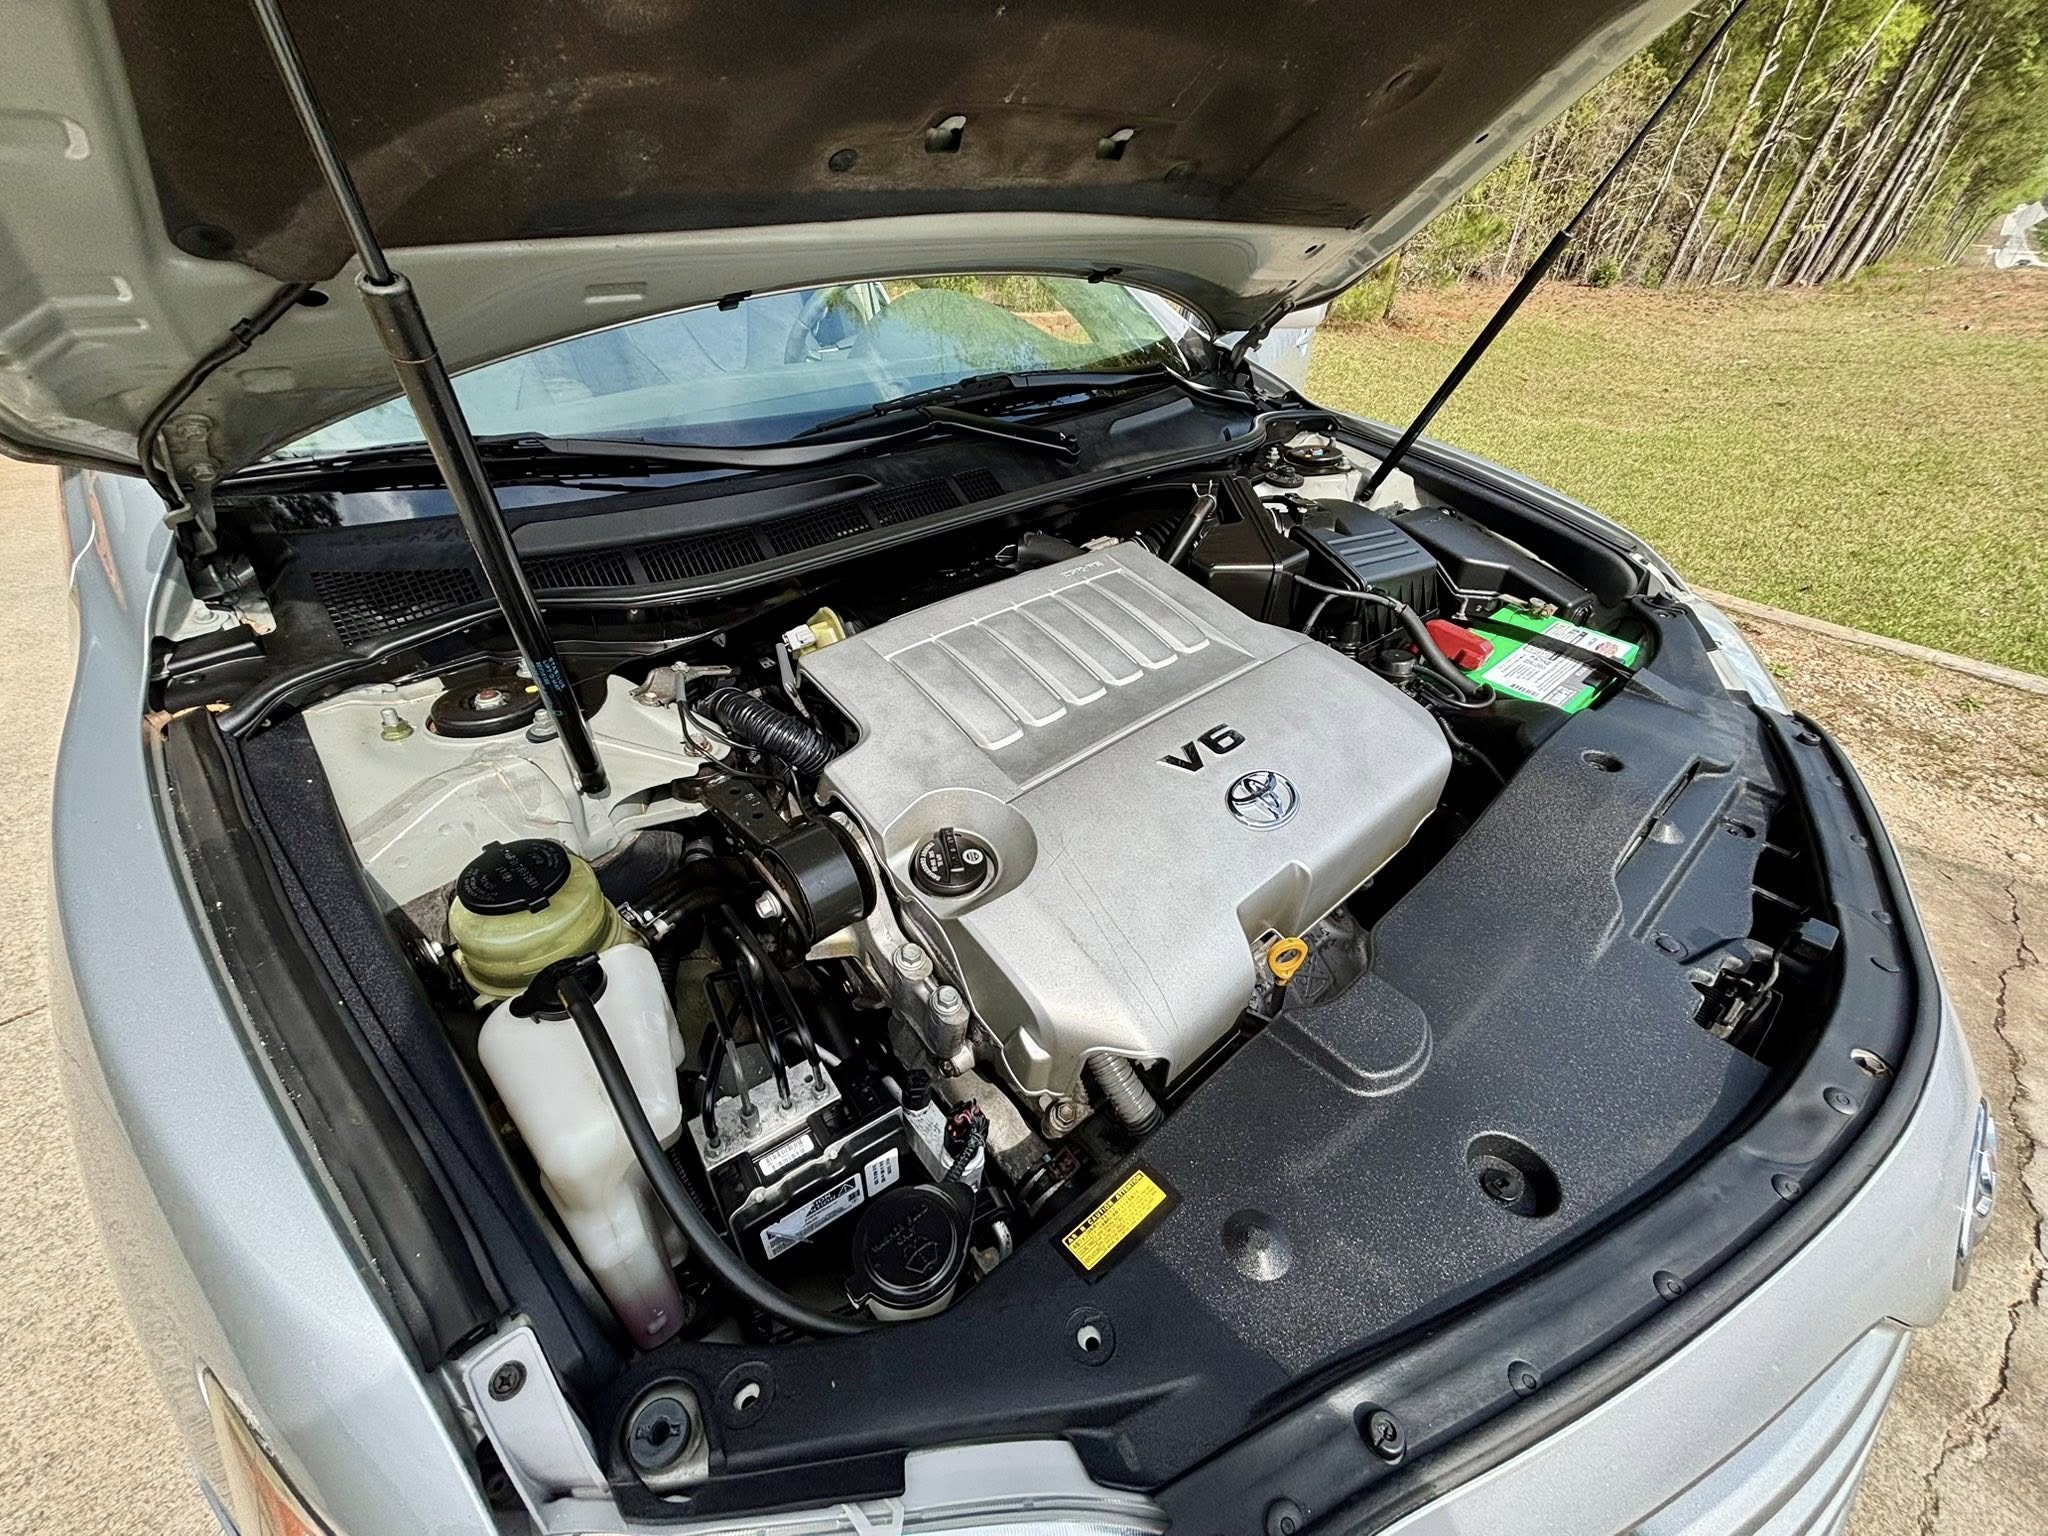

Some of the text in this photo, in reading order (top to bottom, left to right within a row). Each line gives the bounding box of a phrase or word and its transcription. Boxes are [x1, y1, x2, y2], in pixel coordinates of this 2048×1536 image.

[1156, 723, 1246, 773] V6
[1087, 1174, 1143, 1225] CAUTION ATTENTION
